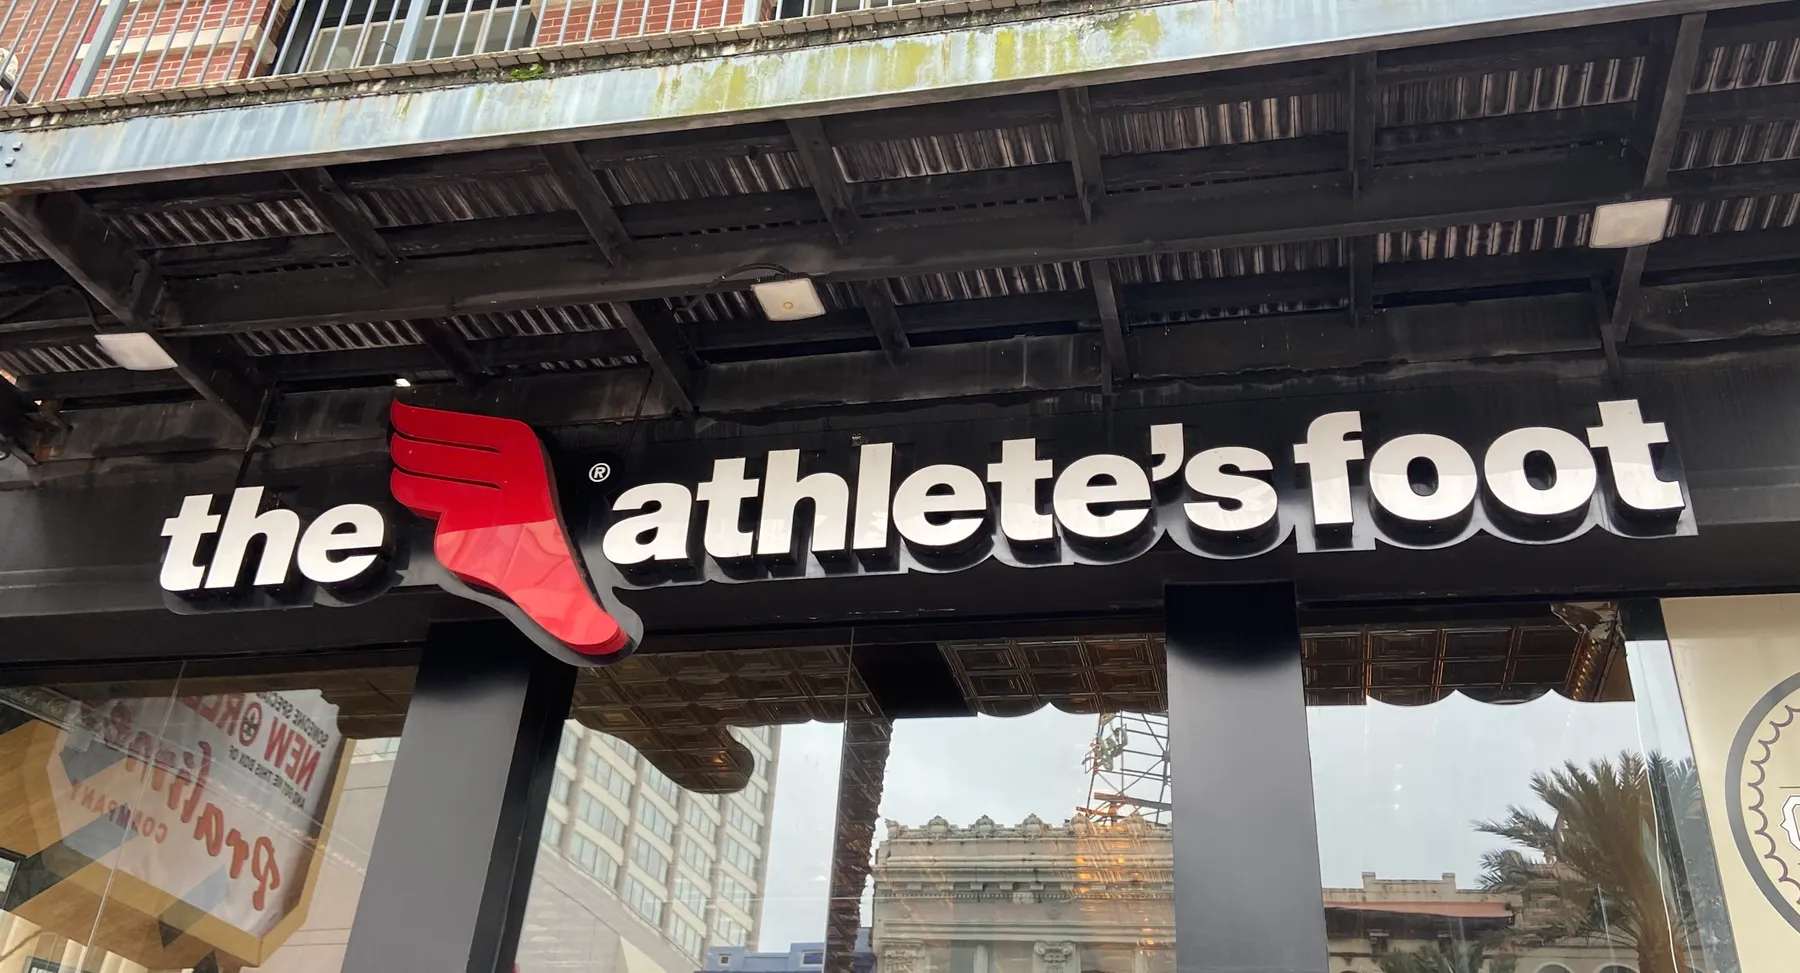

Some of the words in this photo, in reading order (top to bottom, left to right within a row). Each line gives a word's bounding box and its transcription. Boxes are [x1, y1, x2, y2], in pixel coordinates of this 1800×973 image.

[159, 485, 386, 592] the
[603, 422, 1279, 566] athlete's
[1293, 398, 1687, 527] foot
